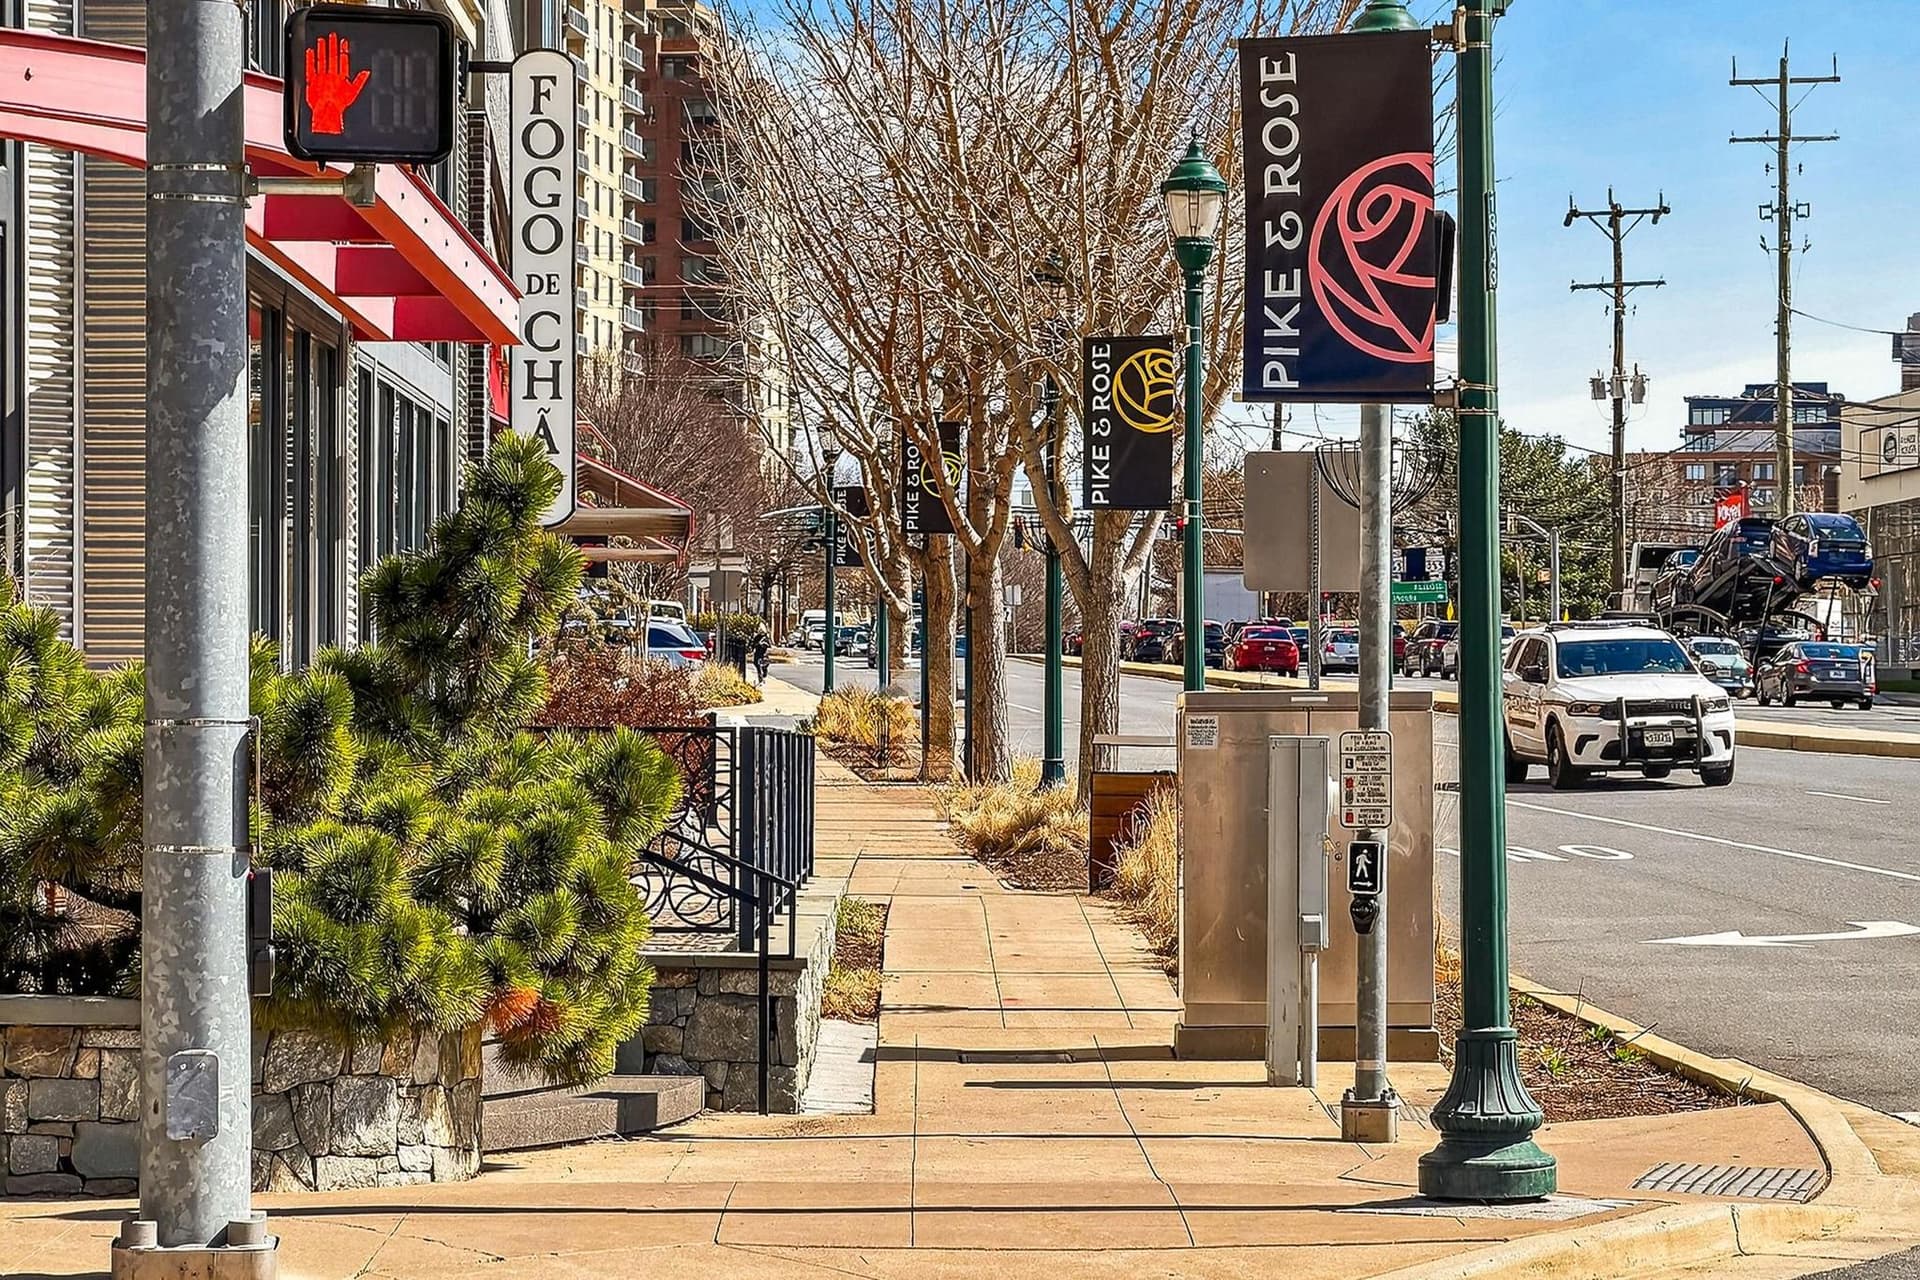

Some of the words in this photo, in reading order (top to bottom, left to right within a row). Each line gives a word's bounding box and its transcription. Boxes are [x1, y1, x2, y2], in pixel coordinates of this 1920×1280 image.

[1260, 51, 1302, 198] ROSE
[521, 75, 565, 256] FOGO
[1265, 210, 1303, 250] &
[525, 273, 560, 295] DE
[1262, 268, 1303, 390] PIKE
[522, 310, 564, 498] CHÃ
[1092, 343, 1112, 412] ROSE
[1092, 418, 1112, 437] &
[1092, 444, 1111, 505] PIKE
[906, 491, 920, 530] PIKE
